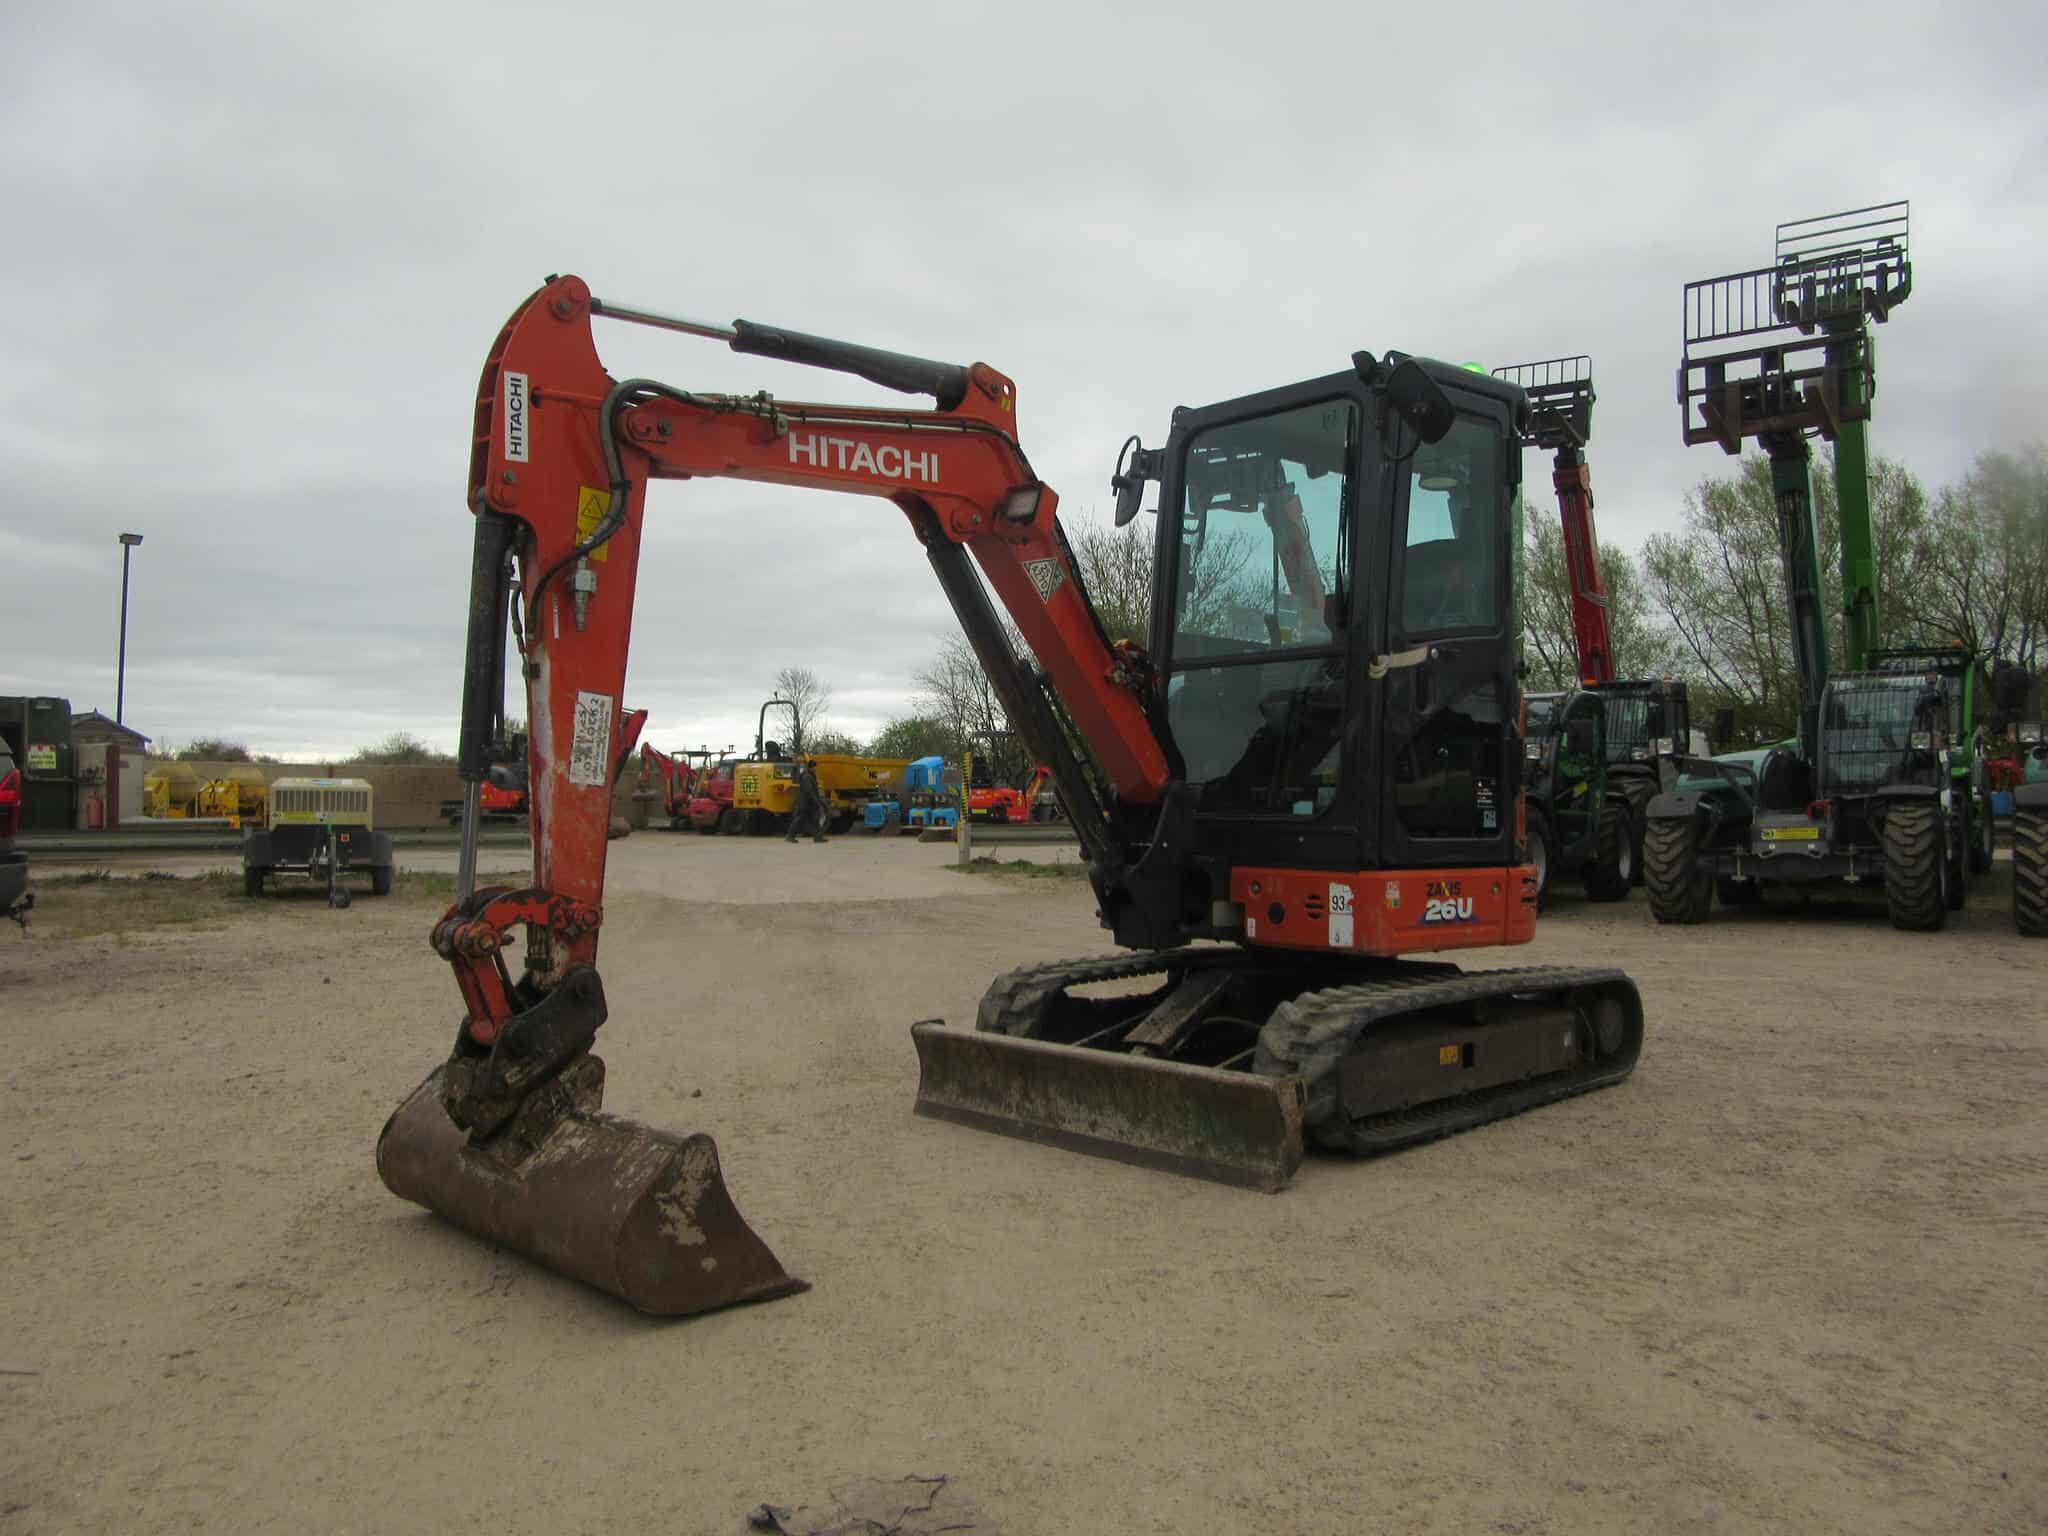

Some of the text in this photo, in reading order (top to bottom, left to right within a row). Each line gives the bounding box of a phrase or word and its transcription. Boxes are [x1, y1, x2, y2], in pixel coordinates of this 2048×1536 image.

[510, 377, 522, 456] HITACHI
[788, 431, 939, 483] HITACHI
[1425, 897, 1473, 920] 26U
